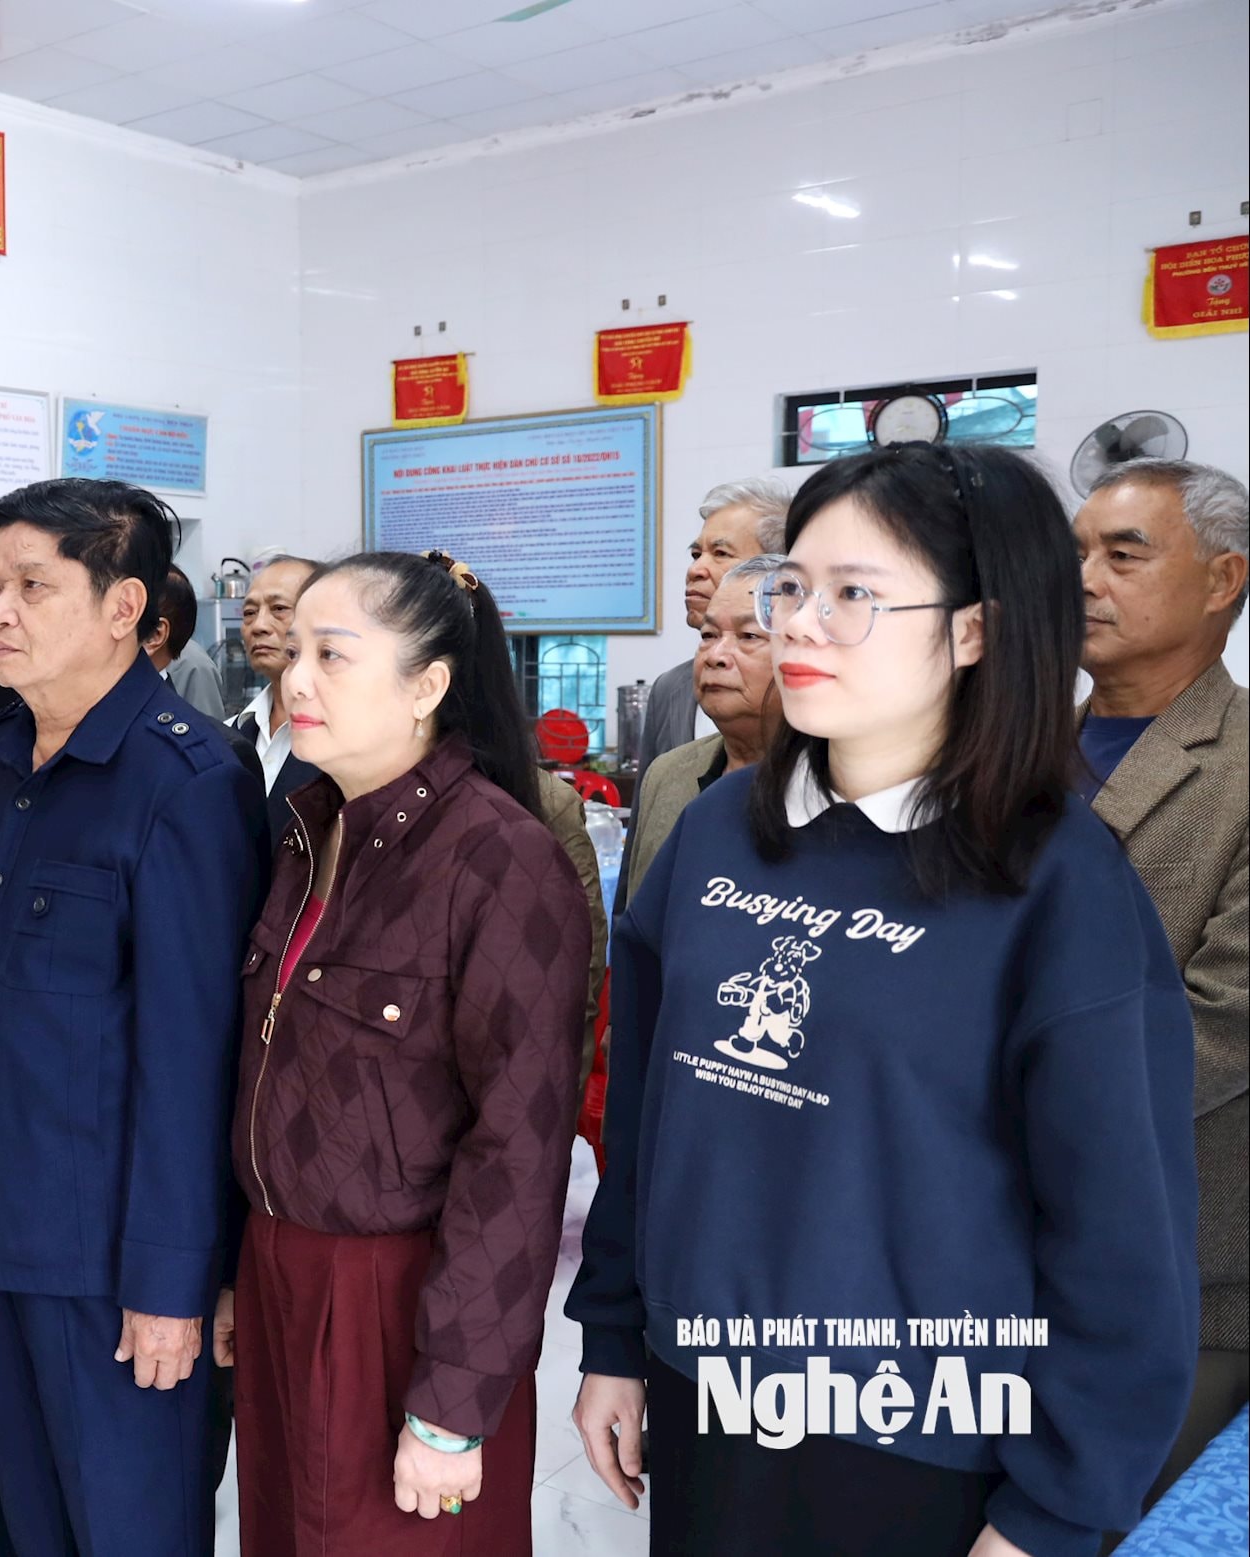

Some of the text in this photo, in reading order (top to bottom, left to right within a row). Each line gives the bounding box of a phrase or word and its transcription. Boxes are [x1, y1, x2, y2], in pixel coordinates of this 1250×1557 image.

[1225, 243, 1249, 253] CHỨ
[701, 876, 926, 954] Busying Day
[673, 1051, 830, 1106] LITTLE PUPPY HAYW A BUSYING DAY ALSO
[695, 1068, 804, 1110] WISH YOU ENJOY EVERY DAY
